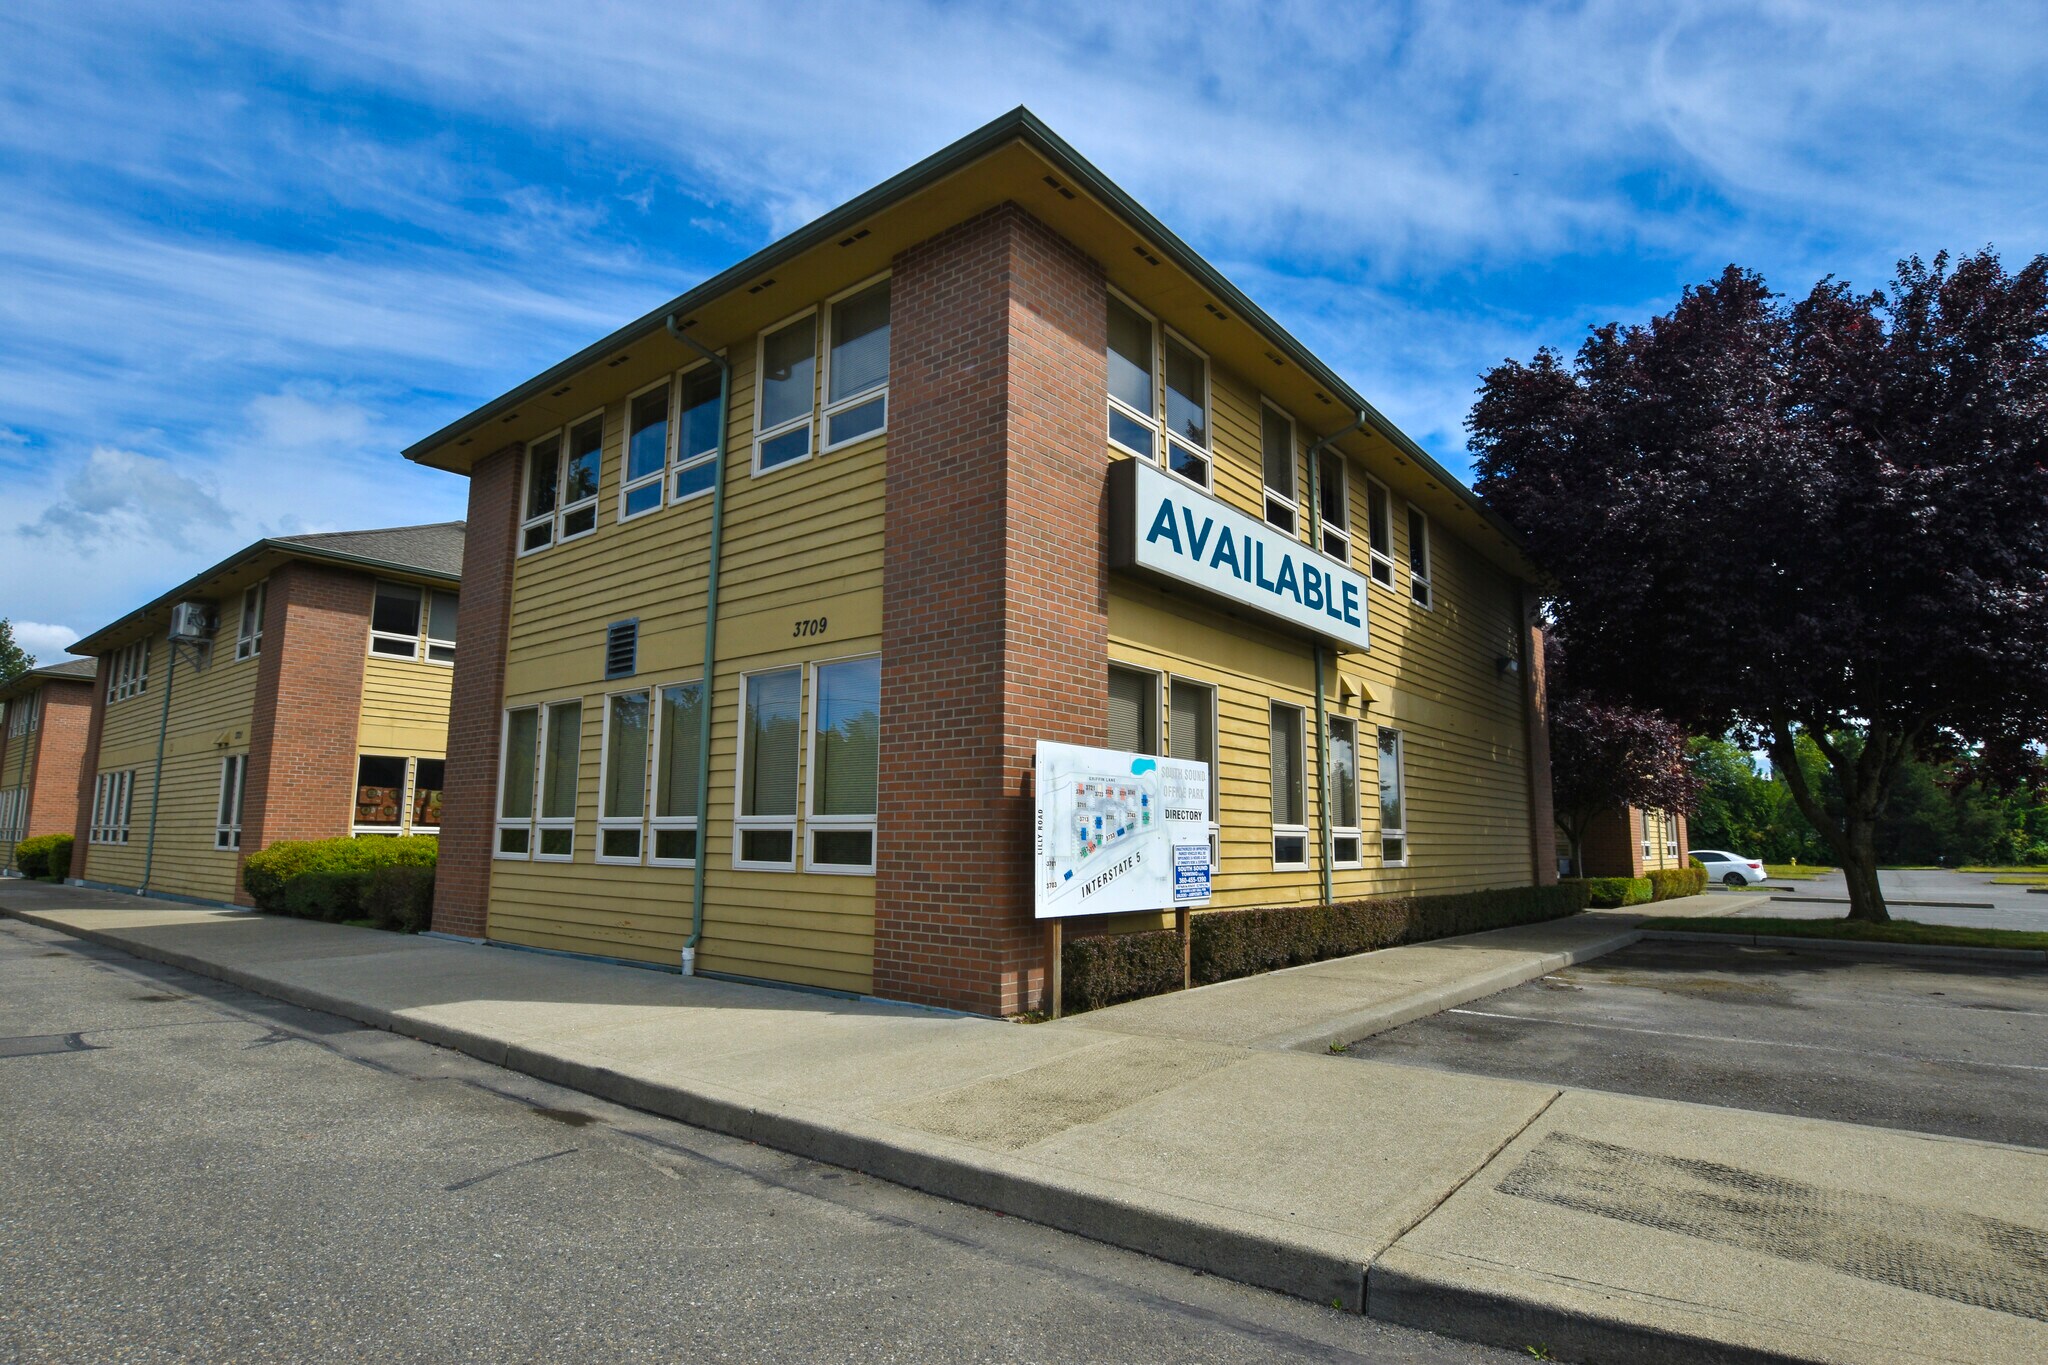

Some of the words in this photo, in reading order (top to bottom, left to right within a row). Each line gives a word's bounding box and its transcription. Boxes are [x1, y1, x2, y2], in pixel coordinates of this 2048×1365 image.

[1146, 498, 1361, 628] AVAILABLE
[793, 616, 828, 638] 3709
[1161, 766, 1183, 780] SOUTH
[1184, 769, 1206, 782] SOUND
[1163, 785, 1187, 799] OFFICE
[1188, 787, 1205, 800] PARK
[1164, 808, 1203, 821] DIRECTORY
[1081, 856, 1133, 898] INTERSTATE
[1136, 851, 1141, 863] 5
